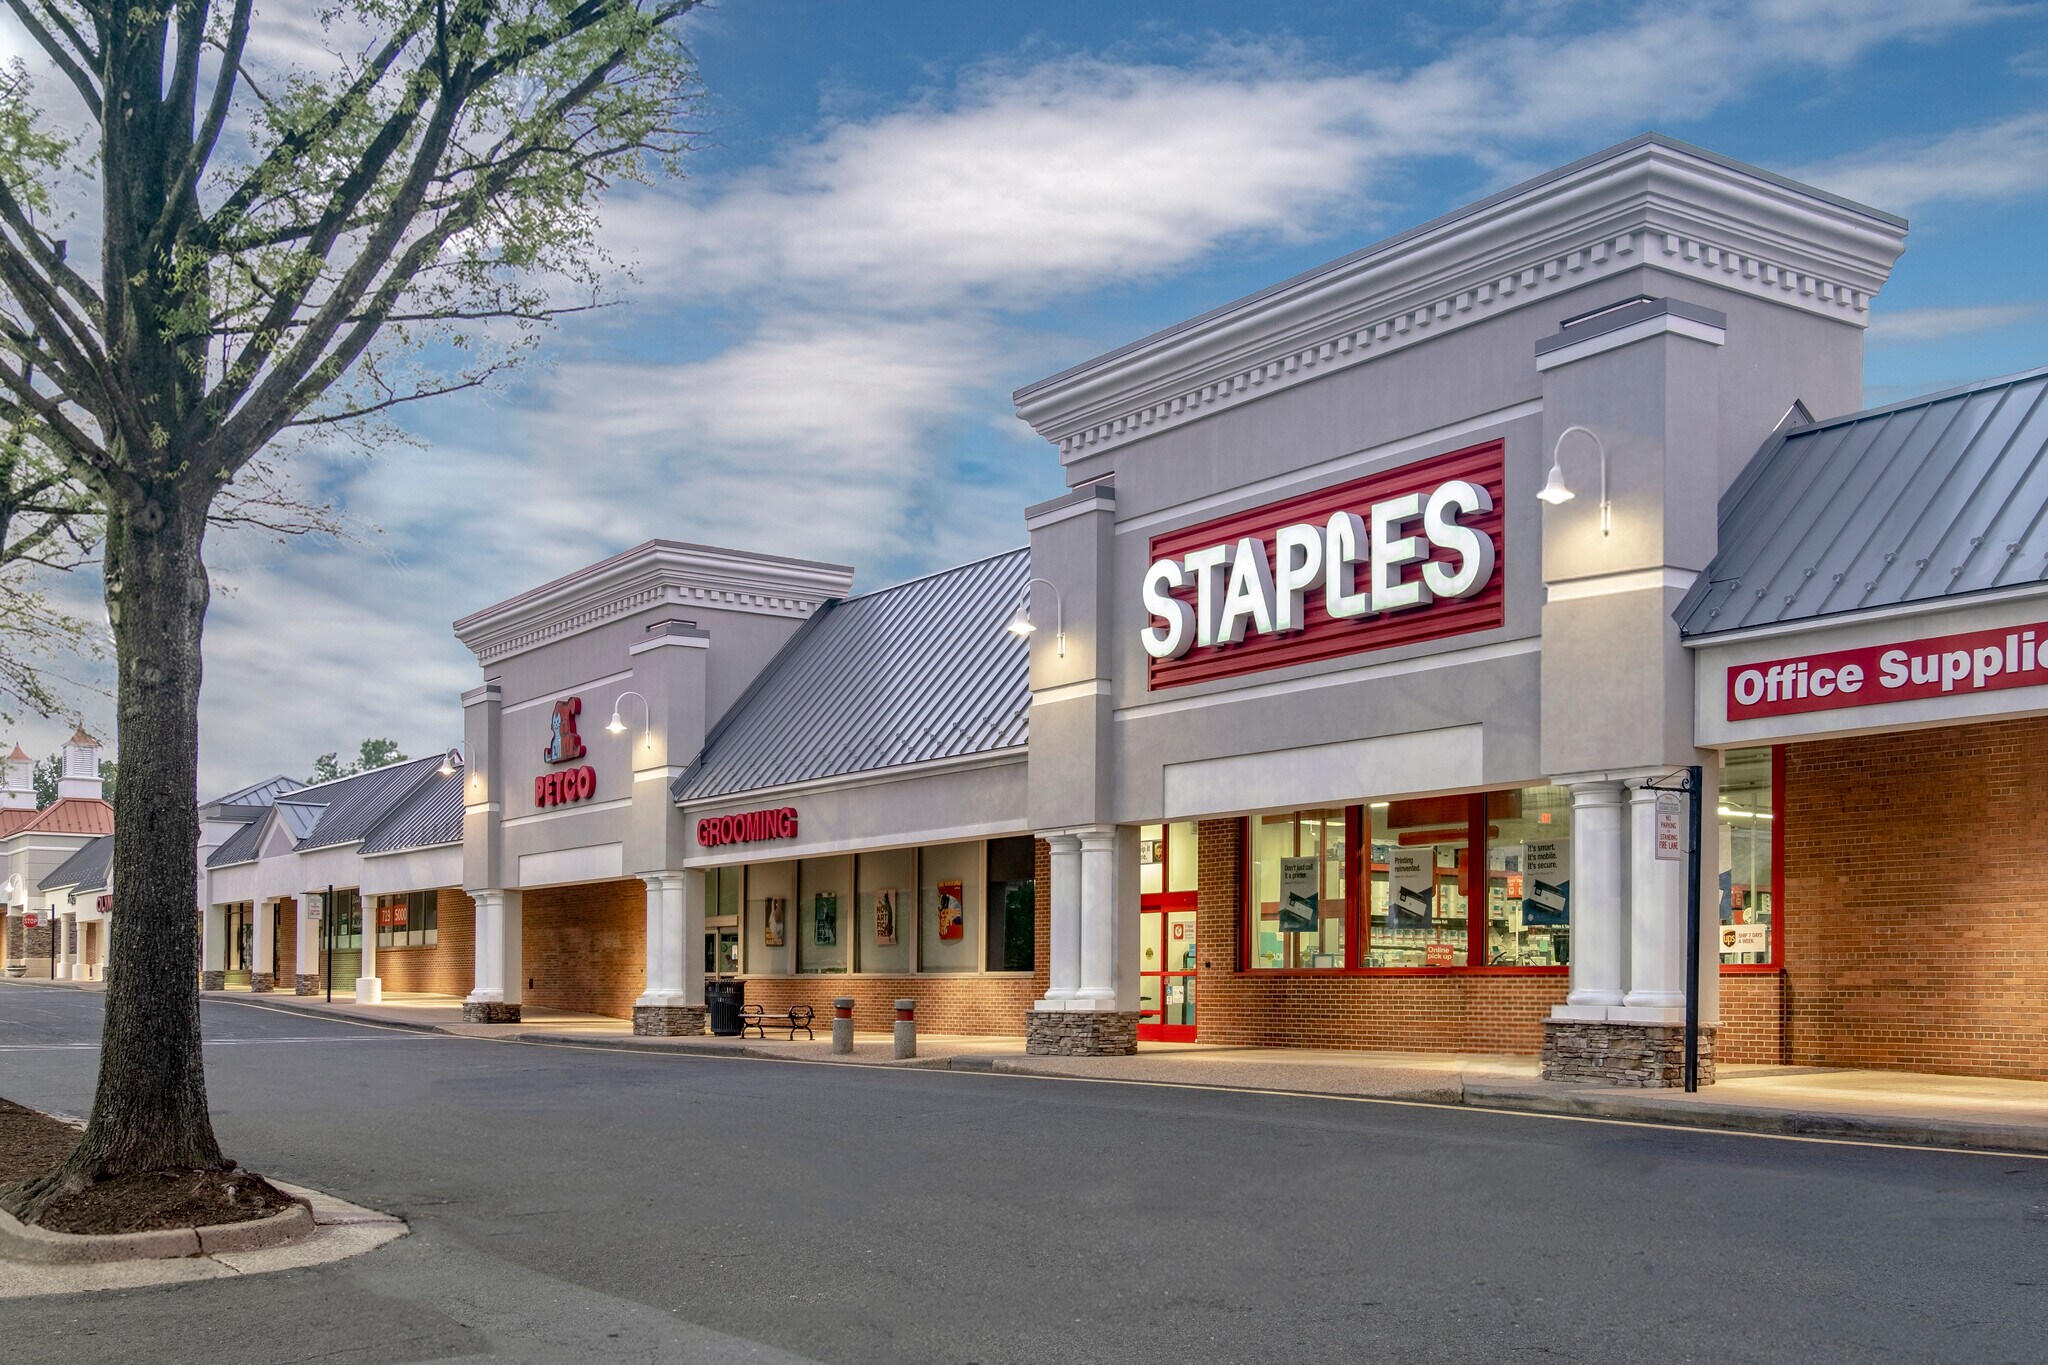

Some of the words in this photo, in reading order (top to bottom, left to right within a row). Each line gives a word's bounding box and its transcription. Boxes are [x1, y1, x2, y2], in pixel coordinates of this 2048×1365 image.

[1140, 480, 1495, 659] STAPLES
[1734, 662, 1864, 706] Office
[535, 766, 597, 808] PETCO
[697, 807, 798, 848] GROOMING
[1660, 821, 1677, 829] PARKING
[1660, 833, 1678, 841] STANDING
[1537, 843, 1556, 852] smart.
[1659, 841, 1667, 849] FIRE
[1394, 857, 1414, 865] Printing
[1527, 853, 1537, 861] It's
[1537, 852, 1558, 860] mobile.
[1284, 864, 1296, 872] Don't
[1296, 864, 1305, 873] just
[1305, 863, 1314, 871] call
[1394, 864, 1421, 872] reinvented.
[1527, 862, 1537, 870] It's
[1537, 861, 1558, 869] secure.
[1292, 872, 1308, 880] printer.
[1724, 934, 1736, 945] ups
[1427, 946, 1450, 954] Online
